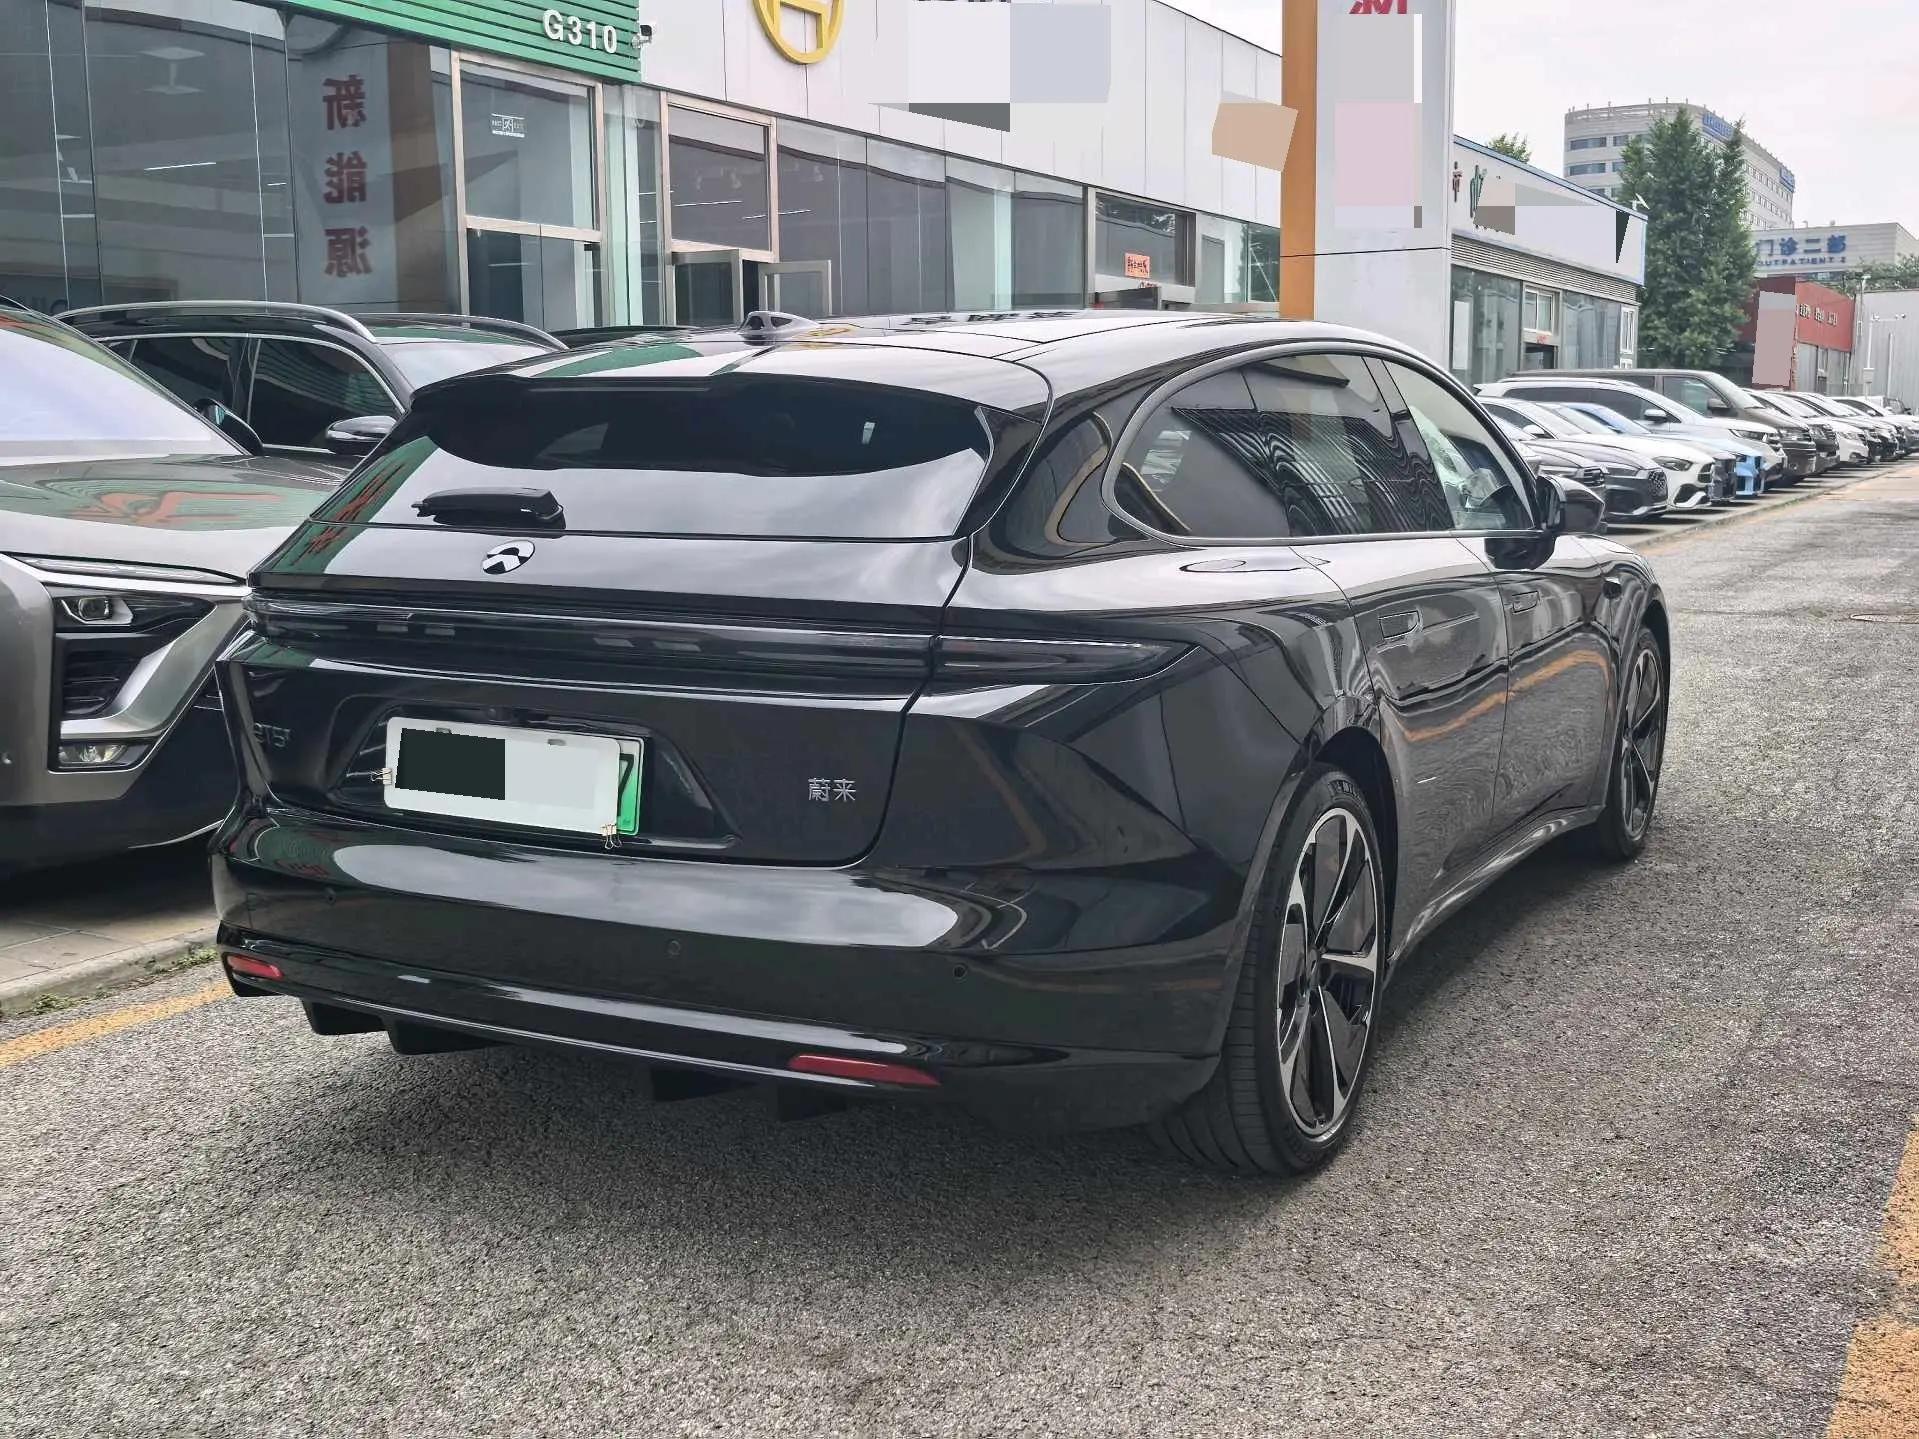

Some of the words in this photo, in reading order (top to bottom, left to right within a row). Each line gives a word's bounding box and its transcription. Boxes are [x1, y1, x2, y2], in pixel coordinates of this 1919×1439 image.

[543, 9, 617, 53] G310
[1755, 234, 1846, 256] 门诊二部
[808, 778, 857, 801] 蔚来
